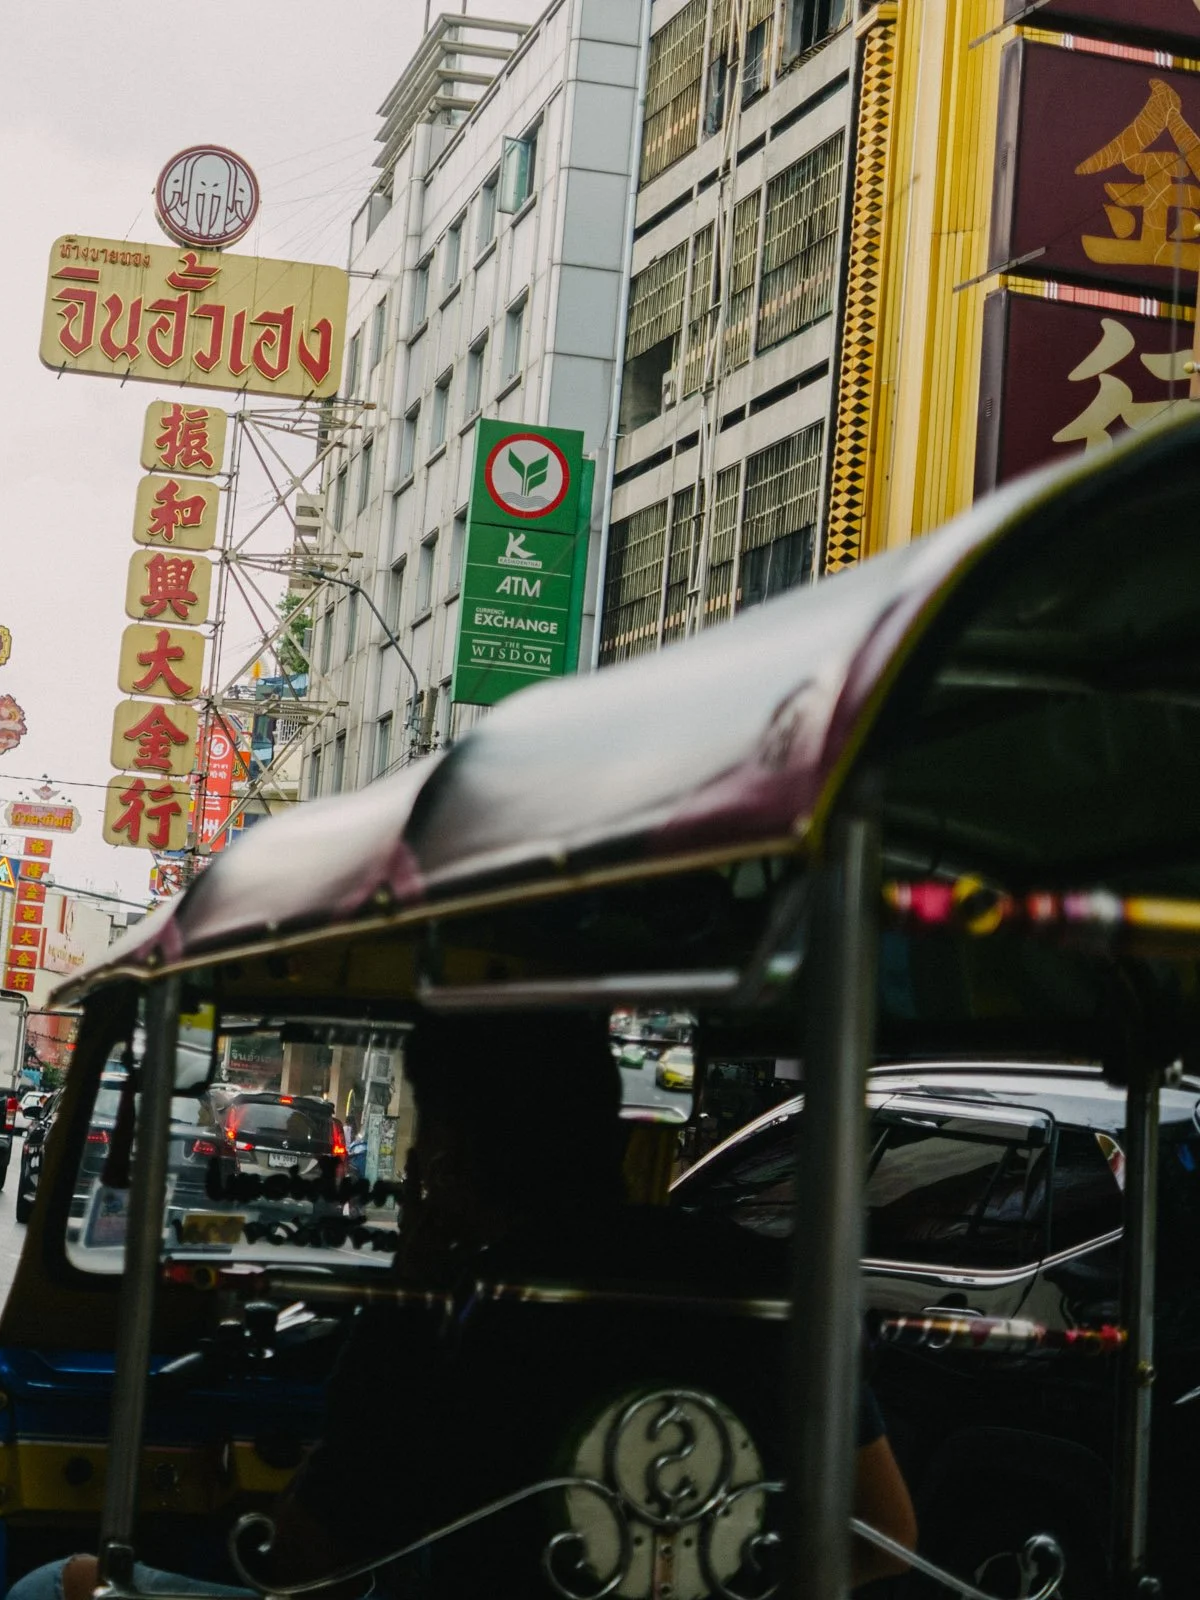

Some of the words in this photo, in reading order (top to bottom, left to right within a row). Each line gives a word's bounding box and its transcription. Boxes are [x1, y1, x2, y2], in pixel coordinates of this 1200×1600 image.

[51, 251, 334, 387] จินฮั้วเฮง
[496, 575, 541, 598] ATM
[111, 402, 215, 850] 振和興大金行
[474, 614, 558, 635] EXCHANGE
[471, 645, 552, 666] WISDOM
[504, 641, 521, 649] THE
